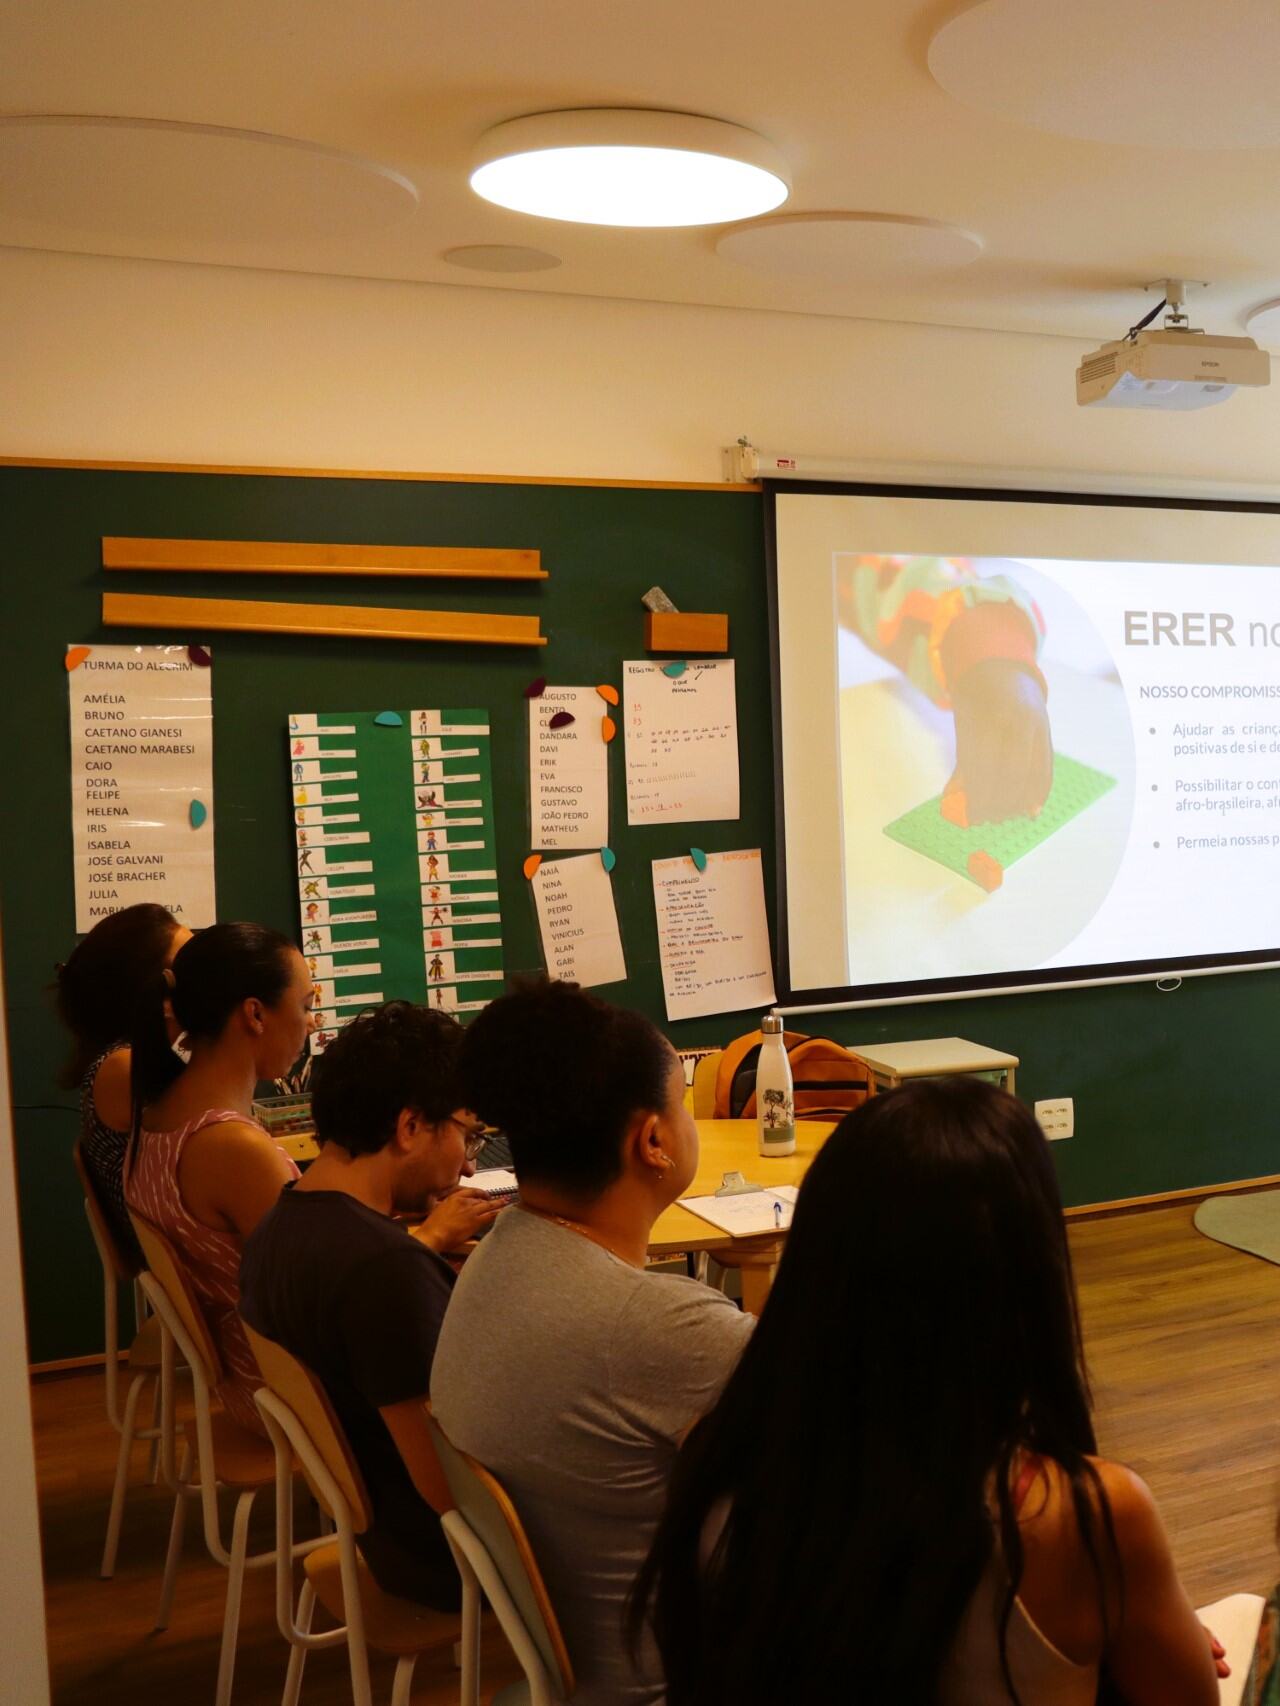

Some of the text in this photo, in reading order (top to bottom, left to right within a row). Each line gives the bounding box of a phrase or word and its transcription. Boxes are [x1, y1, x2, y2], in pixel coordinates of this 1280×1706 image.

[1124, 610, 1236, 647] ERER
[83, 661, 124, 671] TURMA
[127, 661, 143, 671] DO
[1139, 685, 1188, 699] NOSSO
[83, 694, 126, 704] AMÉLIA
[84, 711, 125, 721] BRUNO
[84, 728, 182, 738] CAETANO GIANESI
[1173, 722, 1214, 739] Ajudar
[1221, 725, 1236, 736] as
[540, 732, 578, 740] DANDARA
[85, 745, 195, 755] CAETANO MARABESI
[540, 745, 558, 753] DAVI
[1173, 742, 1228, 757] positivas
[1230, 741, 1245, 754] de
[1247, 741, 1257, 753] si
[1259, 743, 1267, 753] e
[85, 761, 113, 771] CAIO
[540, 773, 556, 781] EVA
[86, 778, 118, 788] DORA
[1175, 778, 1242, 792] Possibilitar
[1245, 780, 1254, 791] o
[540, 785, 583, 793] FRANCISCO
[86, 790, 120, 800] FELIPE
[541, 799, 578, 807] GUSTAVO
[86, 807, 129, 817] HELENA
[541, 811, 589, 820] JOÃO PEDRO
[87, 824, 107, 833] IRIS
[541, 825, 579, 833] MATHEUS
[87, 840, 131, 850] ISABELA
[541, 838, 558, 846] MEL
[1176, 835, 1228, 849] Permeia
[1230, 835, 1270, 847] nossas
[87, 854, 163, 866] JOSÉ GALVANI
[88, 871, 166, 883] JOSÉ BRACHER
[542, 880, 562, 890] NINA
[545, 892, 568, 903] NOAH
[547, 904, 573, 915] PEDRO
[549, 918, 570, 928] RYAN
[554, 944, 575, 954] ALAN
[556, 957, 575, 967] GABI
